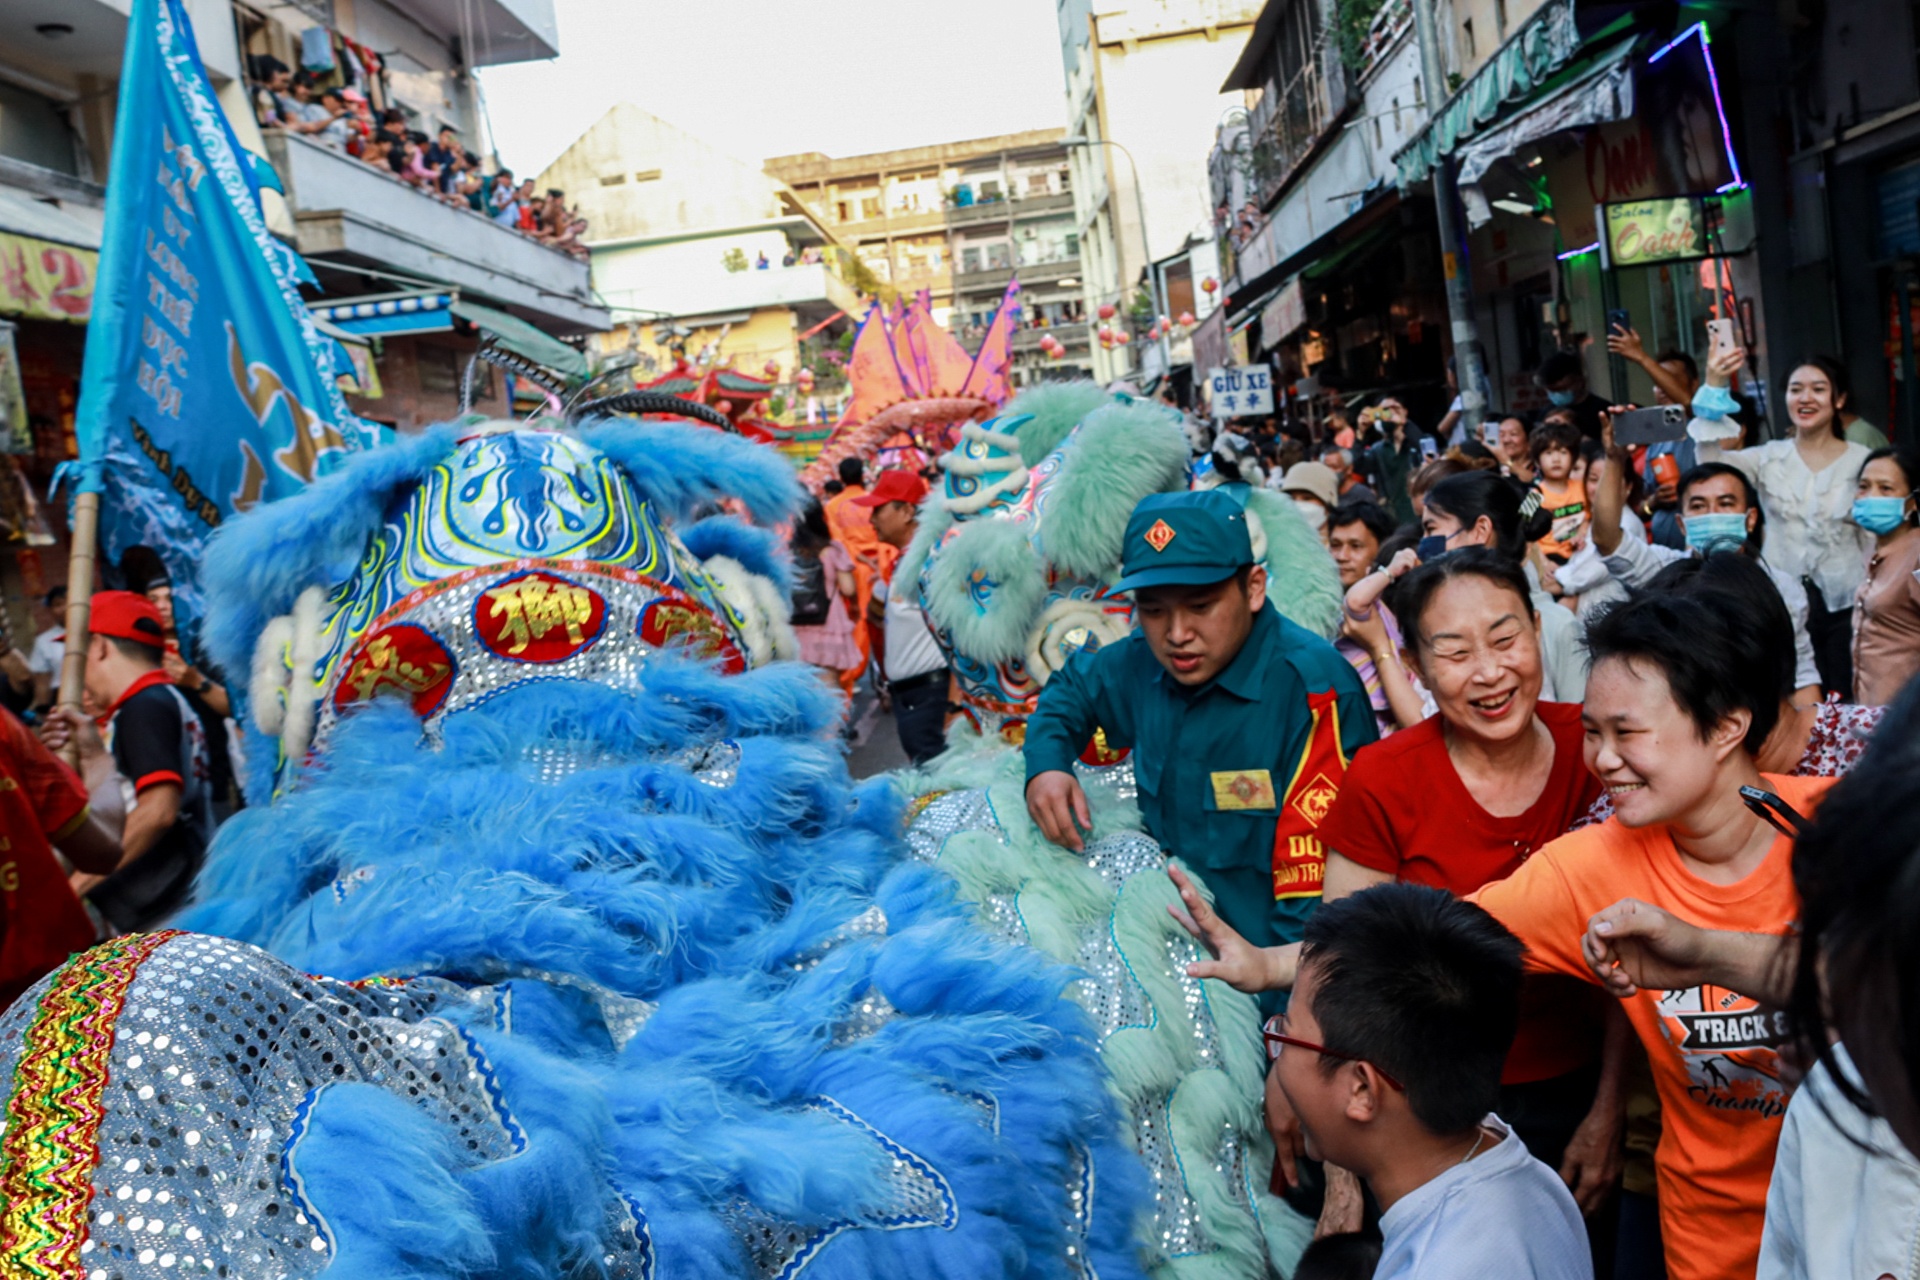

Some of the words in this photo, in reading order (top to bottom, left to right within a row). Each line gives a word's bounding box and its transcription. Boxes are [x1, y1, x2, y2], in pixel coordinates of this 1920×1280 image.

[1611, 205, 1654, 220] Salon
[1616, 221, 1697, 261] Oanh
[1247, 373, 1268, 390] XE
[1720, 991, 1745, 1009] MA
[1694, 1014, 1770, 1043] TRACK
[1687, 1084, 1787, 1120] Champ
